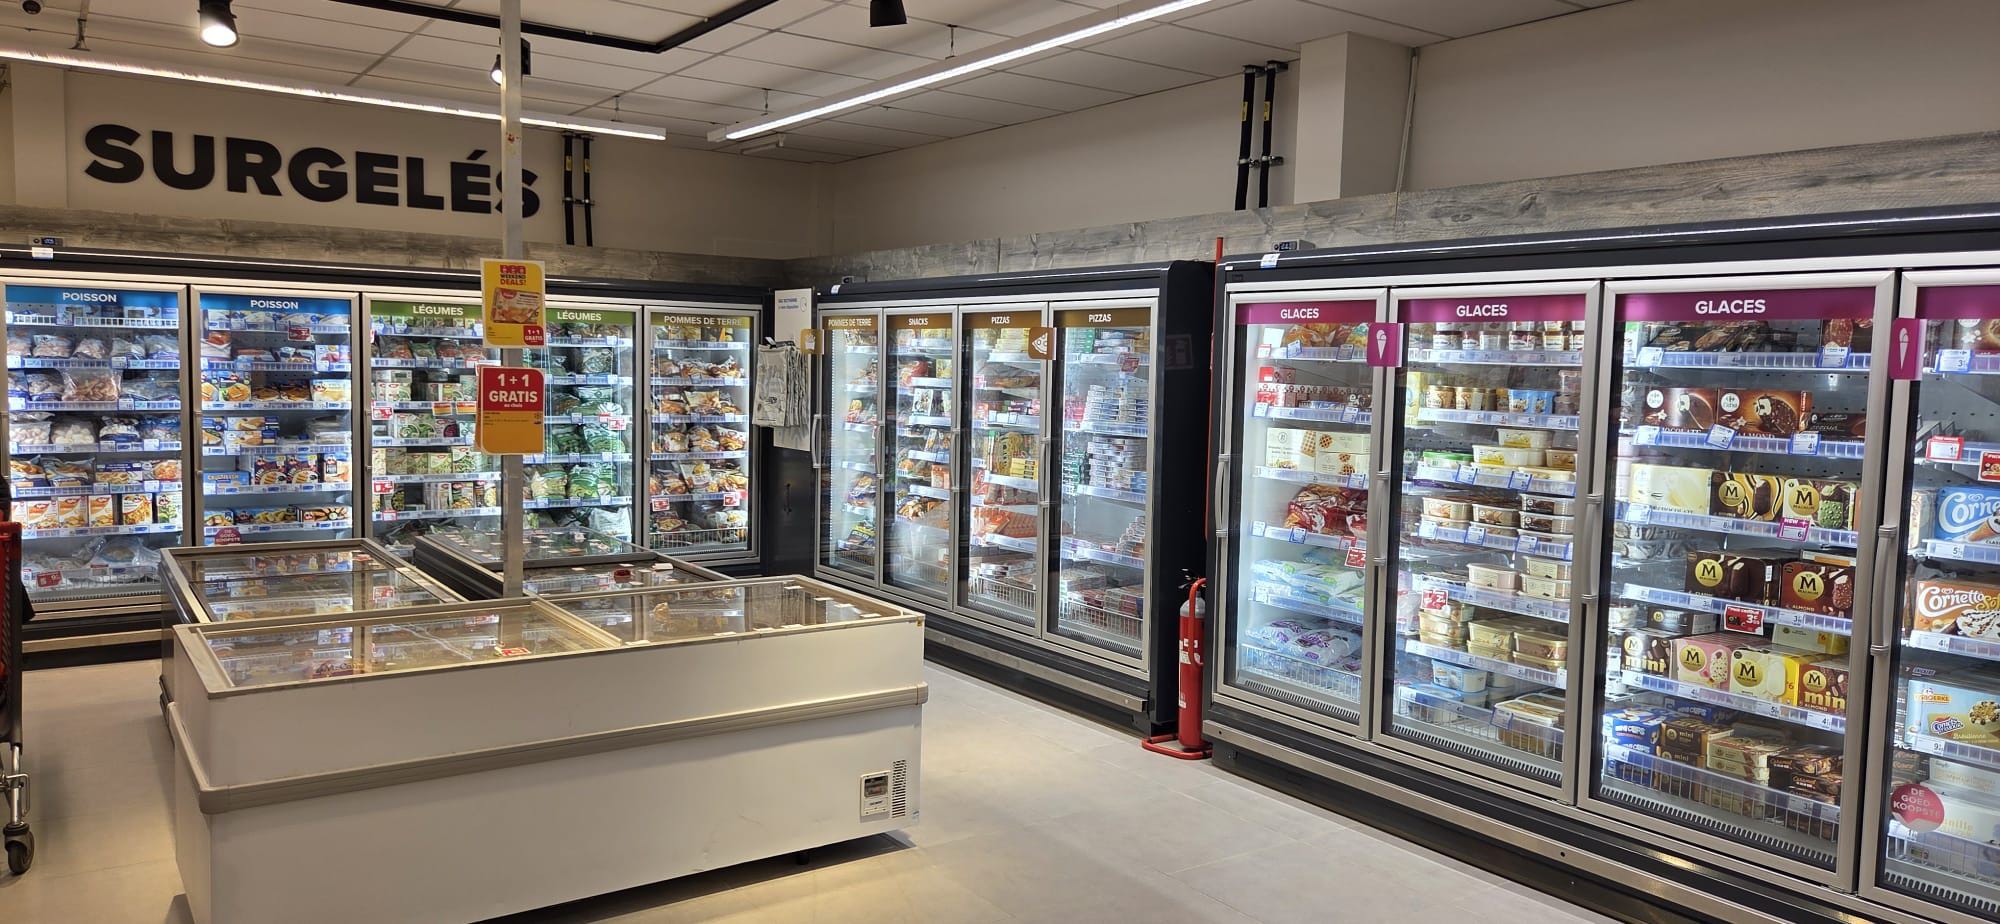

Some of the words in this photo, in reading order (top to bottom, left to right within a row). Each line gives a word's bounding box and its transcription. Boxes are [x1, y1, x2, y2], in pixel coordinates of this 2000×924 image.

[84, 123, 541, 219] SURGELÉS
[62, 292, 117, 303] POISSON
[250, 299, 298, 310] POISSON
[412, 304, 464, 317] LÉGUMES
[1456, 304, 1508, 317] GLACES
[1695, 299, 1766, 315] GLACES
[557, 310, 602, 322] LÉGUMES
[1088, 313, 1112, 323] PIZZAS
[1280, 307, 1320, 319] GLACES
[664, 315, 701, 325] POMMES
[703, 316, 716, 326] DE
[718, 316, 743, 327] TERRE
[855, 318, 871, 326] TERRE
[908, 317, 928, 326] SNACKS
[991, 316, 1010, 324] PIZZAS
[488, 390, 538, 403] GRATIS
[1919, 586, 1985, 617] Cornetto
[1804, 691, 1846, 710] min
[1911, 787, 1925, 797] DE
